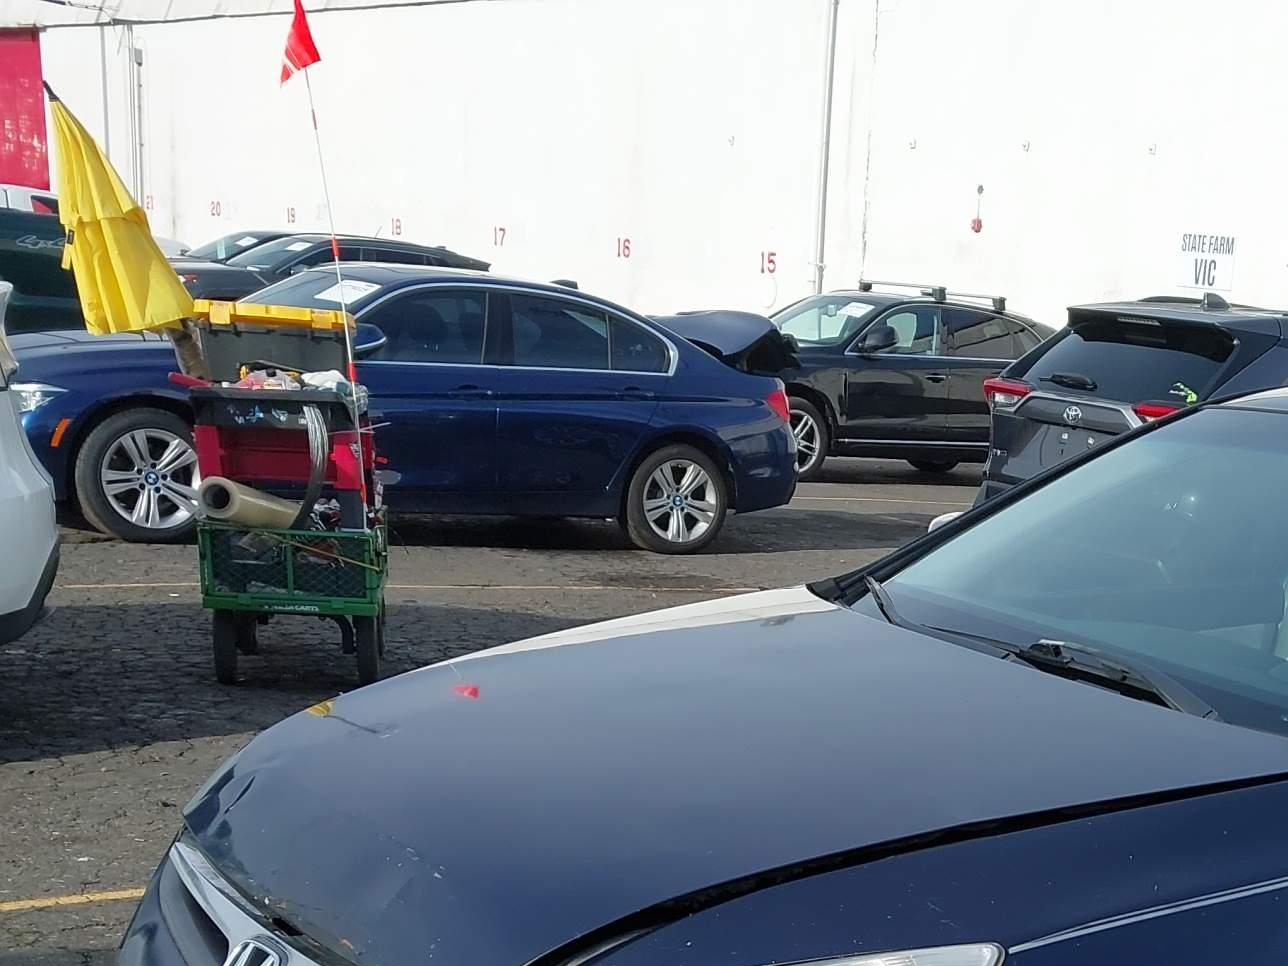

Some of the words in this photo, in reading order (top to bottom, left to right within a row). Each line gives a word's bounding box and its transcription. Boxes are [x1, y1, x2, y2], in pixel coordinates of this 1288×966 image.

[211, 201, 221, 216] 20
[287, 207, 296, 223] 19
[391, 218, 401, 236] 18
[493, 226, 506, 247] 17
[617, 237, 631, 258] 16
[1181, 233, 1207, 253] STATE
[1208, 236, 1235, 255] FARM
[760, 251, 777, 274] 15
[1194, 258, 1217, 287] VIC
